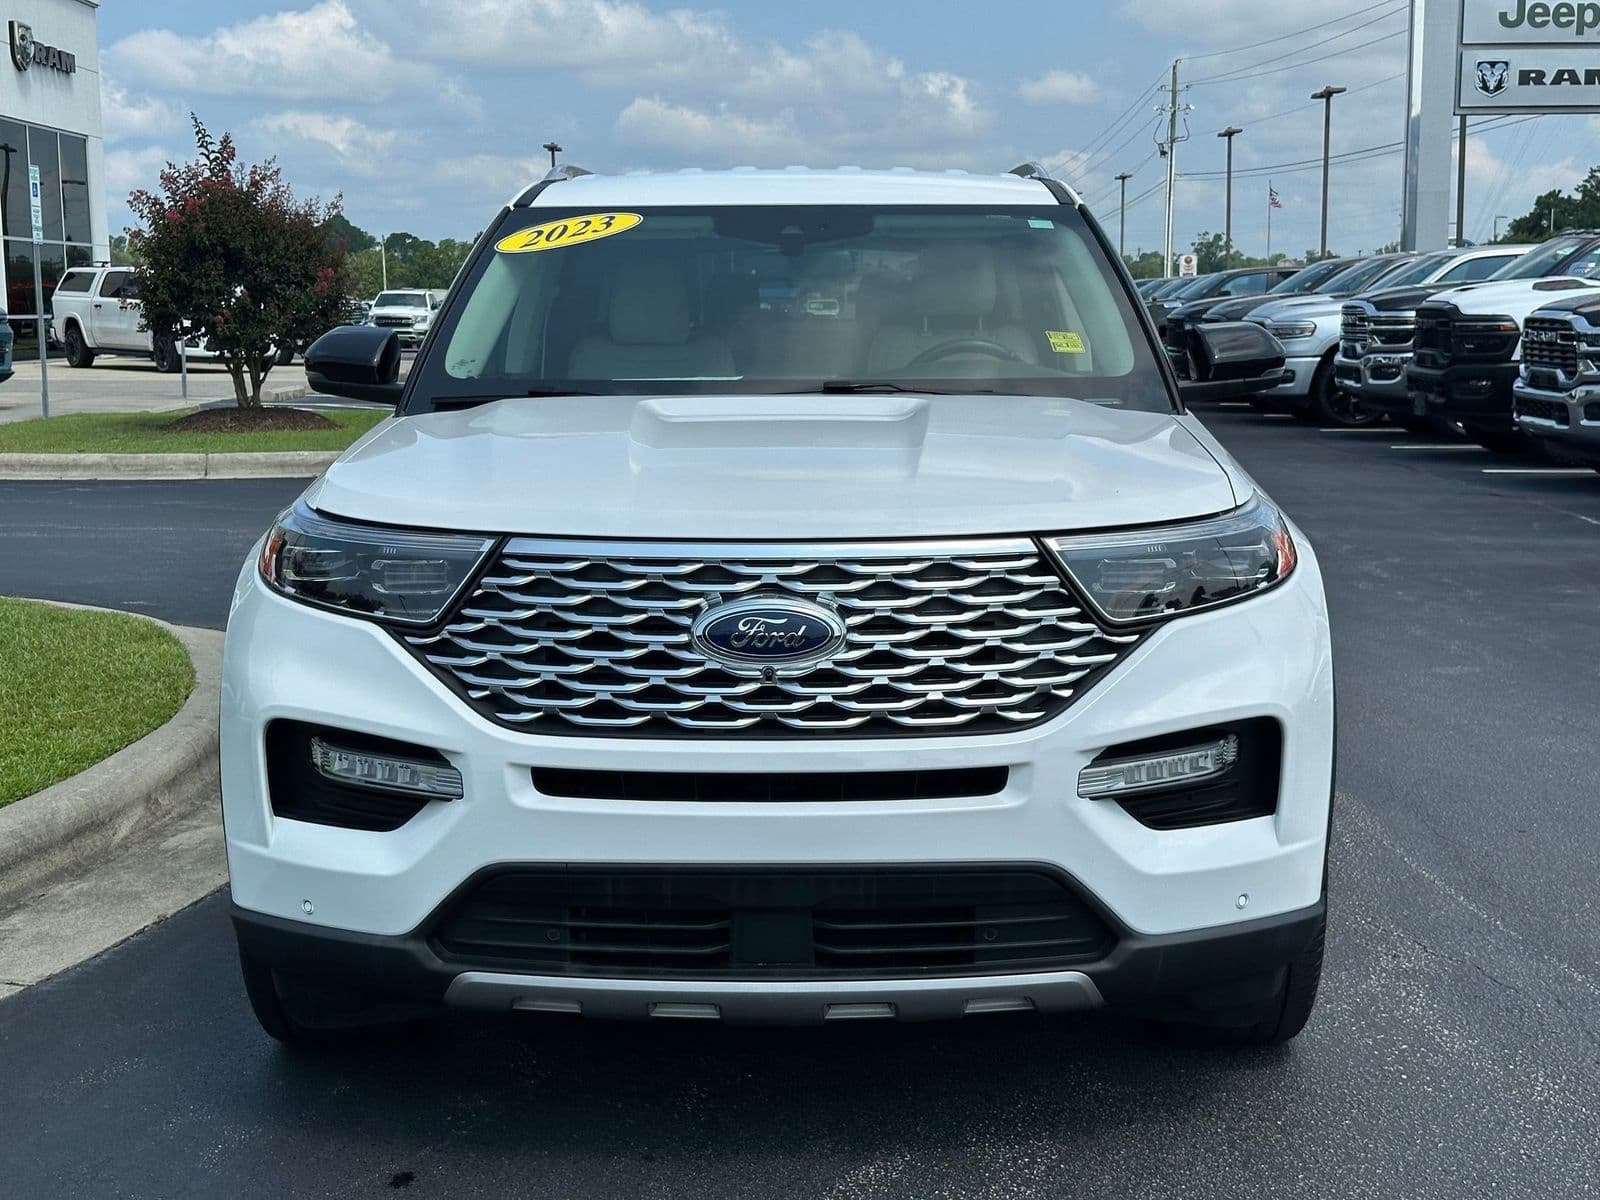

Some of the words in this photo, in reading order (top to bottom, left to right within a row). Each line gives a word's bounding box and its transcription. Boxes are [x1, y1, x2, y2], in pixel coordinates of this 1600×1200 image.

[1498, 0, 1600, 35] Jeep
[32, 41, 76, 73] RAM
[519, 215, 616, 249] 2023
[730, 616, 807, 648] Ford
